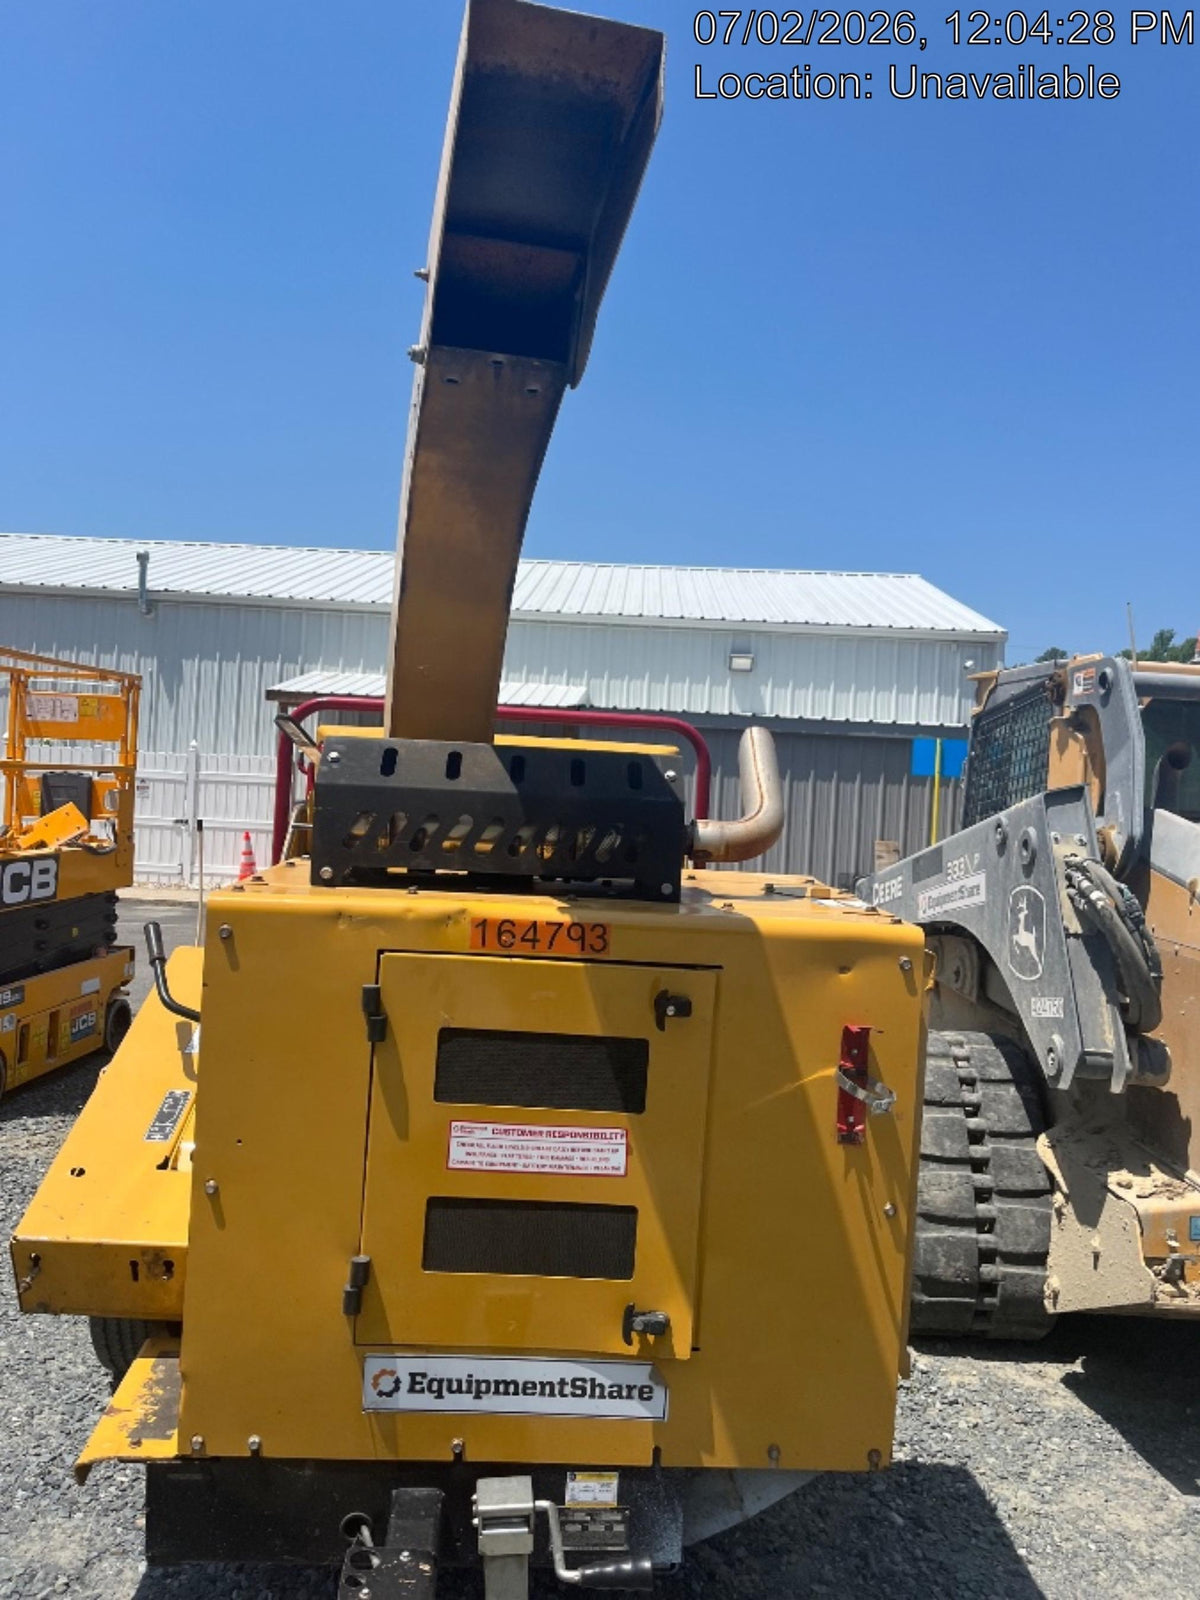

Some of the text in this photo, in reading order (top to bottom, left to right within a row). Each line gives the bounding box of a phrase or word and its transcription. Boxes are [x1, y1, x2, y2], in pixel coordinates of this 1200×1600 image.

[0, 858, 57, 904] CB
[873, 876, 903, 906] DEERE
[474, 918, 609, 953] 164793
[72, 1012, 96, 1034] JCB
[407, 1371, 654, 1401] EquipmentShare
